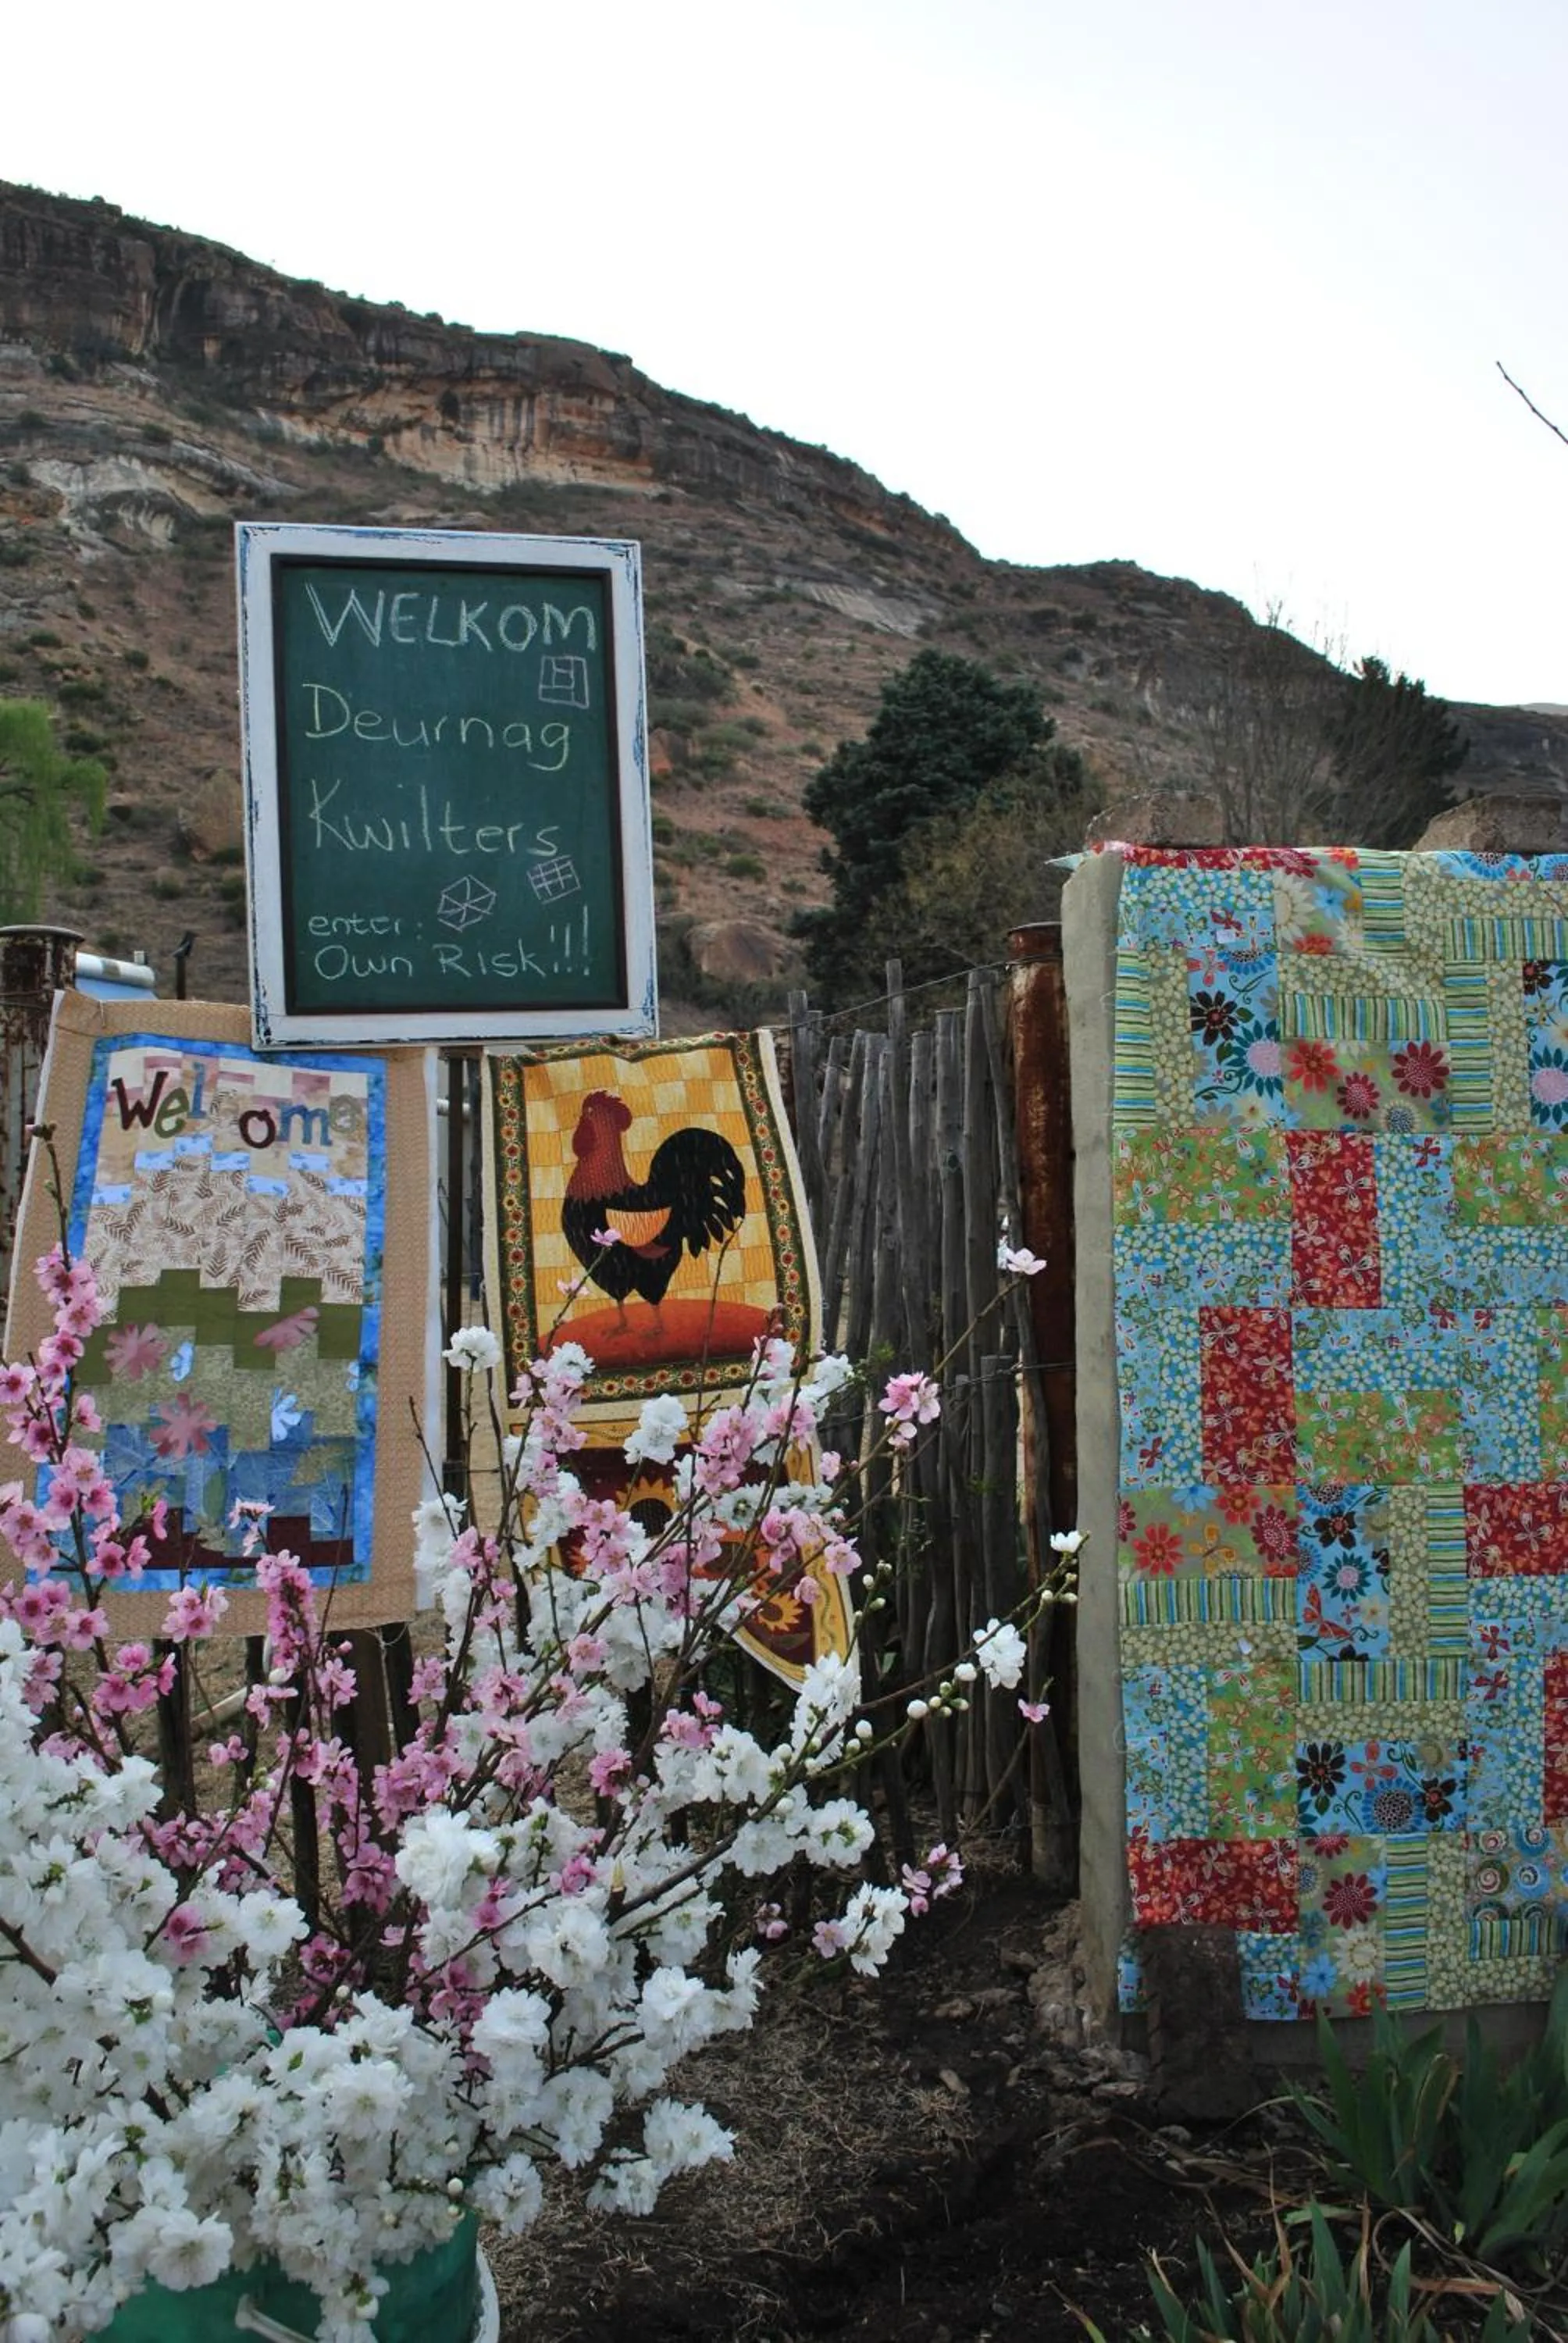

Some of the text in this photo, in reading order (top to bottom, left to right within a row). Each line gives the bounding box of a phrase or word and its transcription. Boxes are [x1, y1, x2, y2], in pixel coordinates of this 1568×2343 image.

[305, 582, 597, 651] WELKOM
[302, 683, 570, 772] Deurnag
[309, 779, 560, 856] Kwilters
[314, 944, 413, 980] Own
